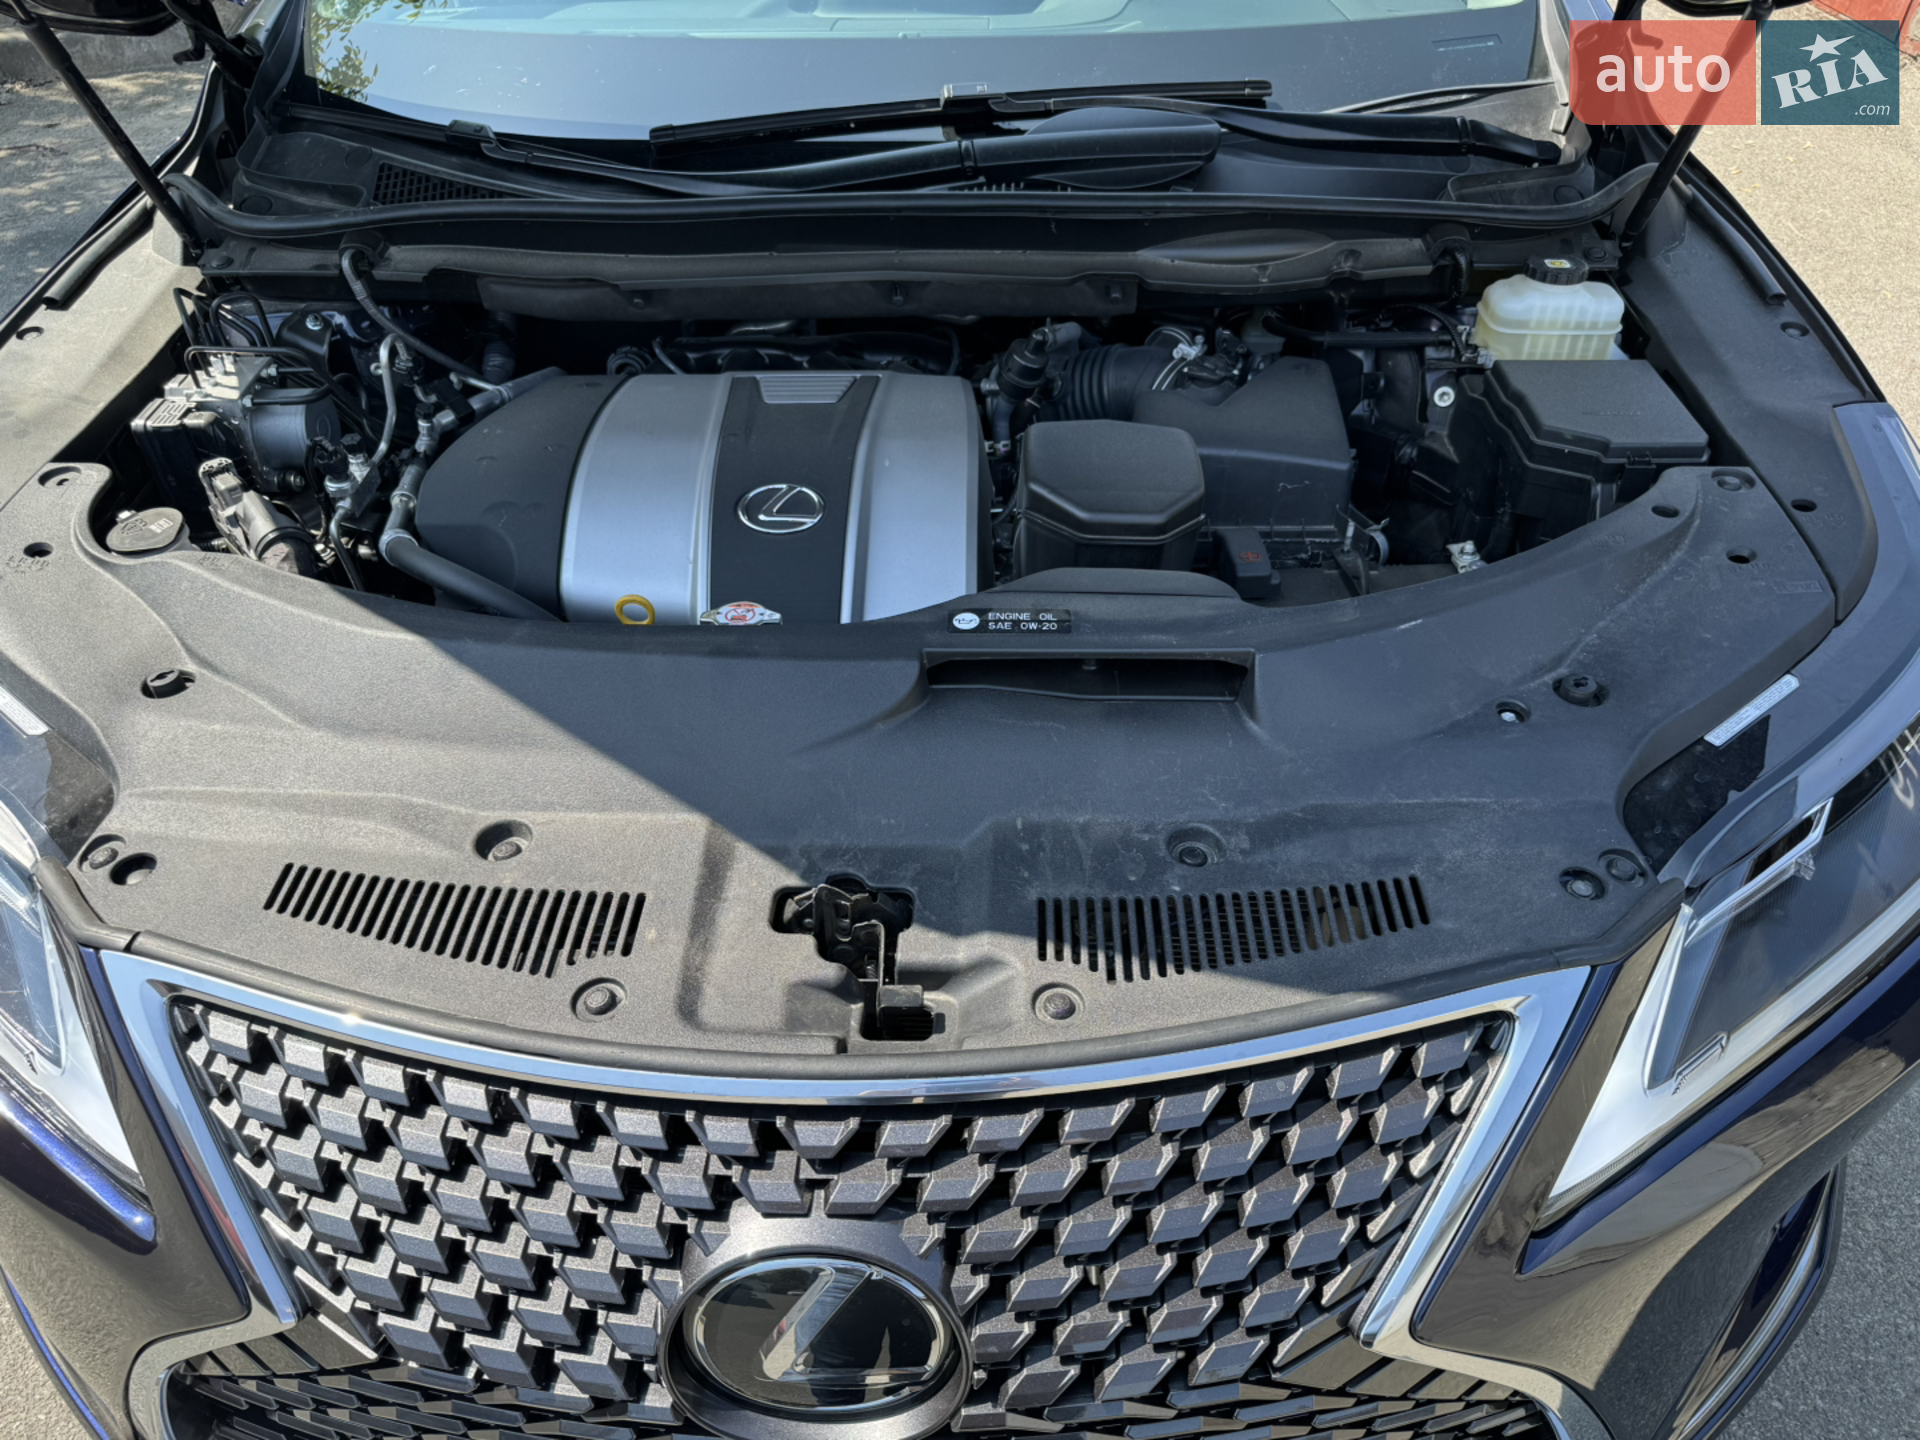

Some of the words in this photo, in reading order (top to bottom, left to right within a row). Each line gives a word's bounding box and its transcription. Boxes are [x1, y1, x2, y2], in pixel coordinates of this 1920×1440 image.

[987, 612, 1032, 621] ENGINE
[1038, 612, 1058, 621] OIL
[987, 621, 1013, 630] SAE
[1020, 621, 1058, 630] 0W-20
